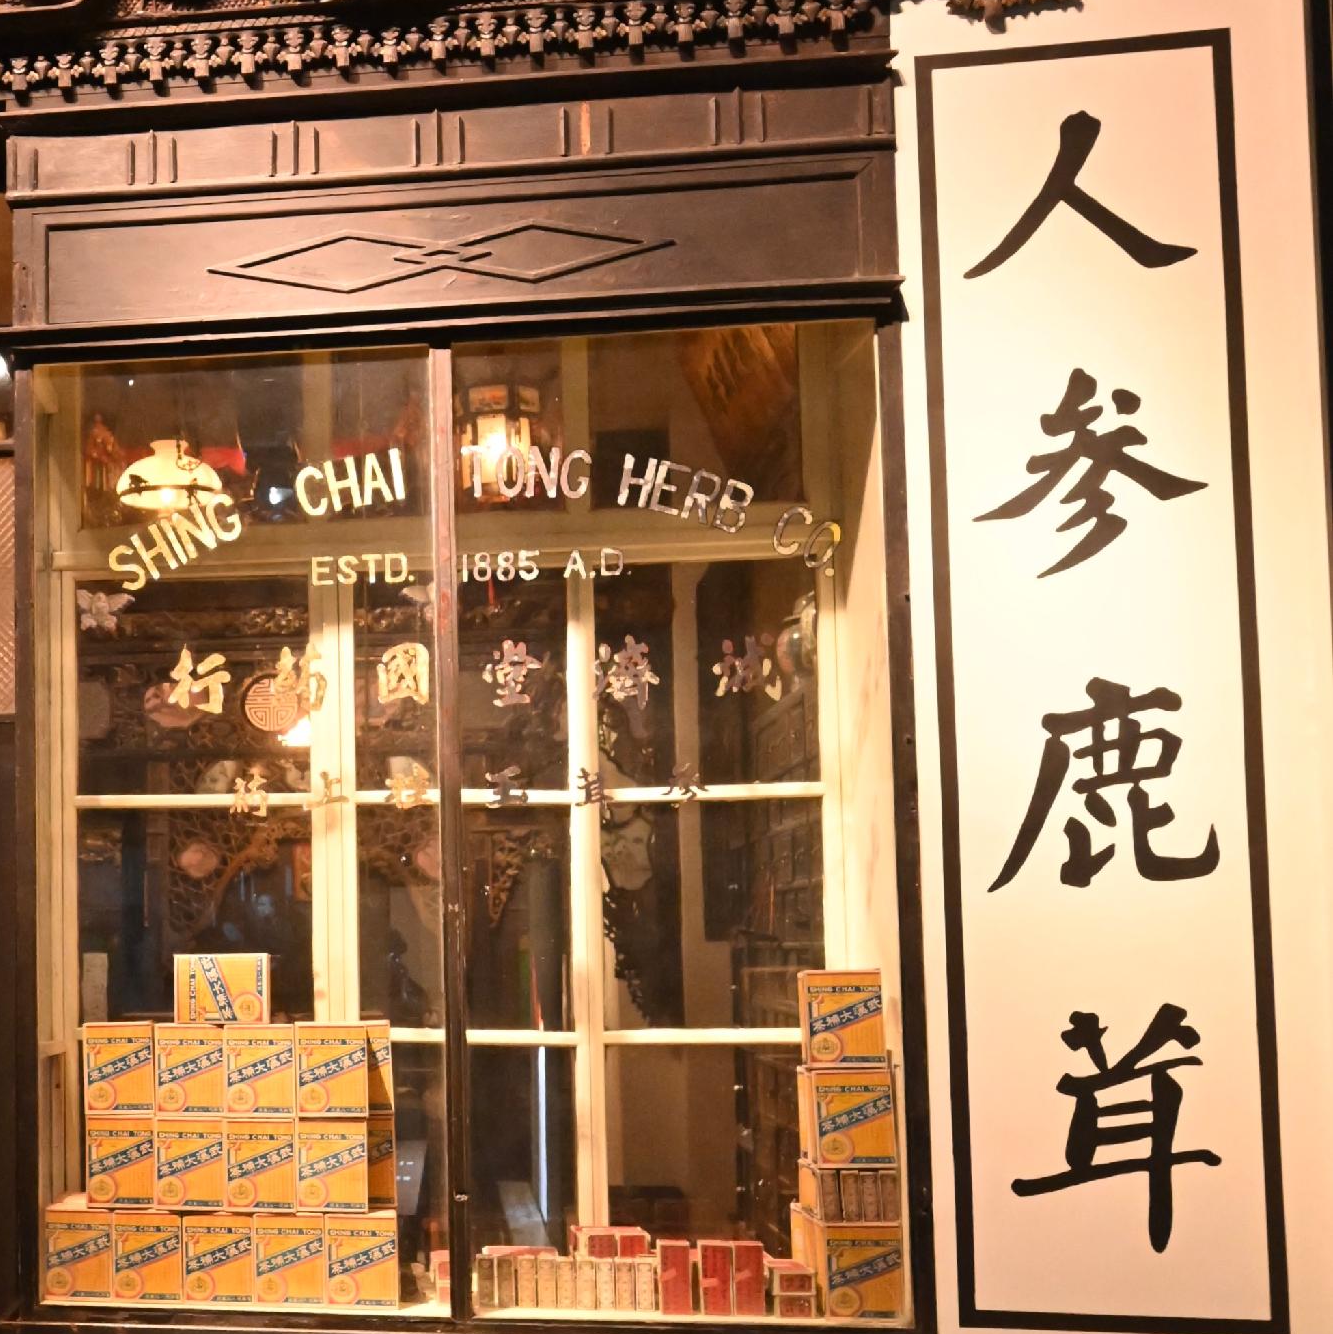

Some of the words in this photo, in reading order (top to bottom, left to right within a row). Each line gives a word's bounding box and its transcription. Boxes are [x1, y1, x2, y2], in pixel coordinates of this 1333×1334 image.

[108, 493, 243, 591] SHING
[294, 447, 406, 517] CHAI
[460, 444, 593, 499] TONG
[617, 453, 755, 534] HERB
[311, 553, 416, 586] ESTD.
[461, 549, 540, 584] 1885
[562, 547, 632, 580] A.D.
